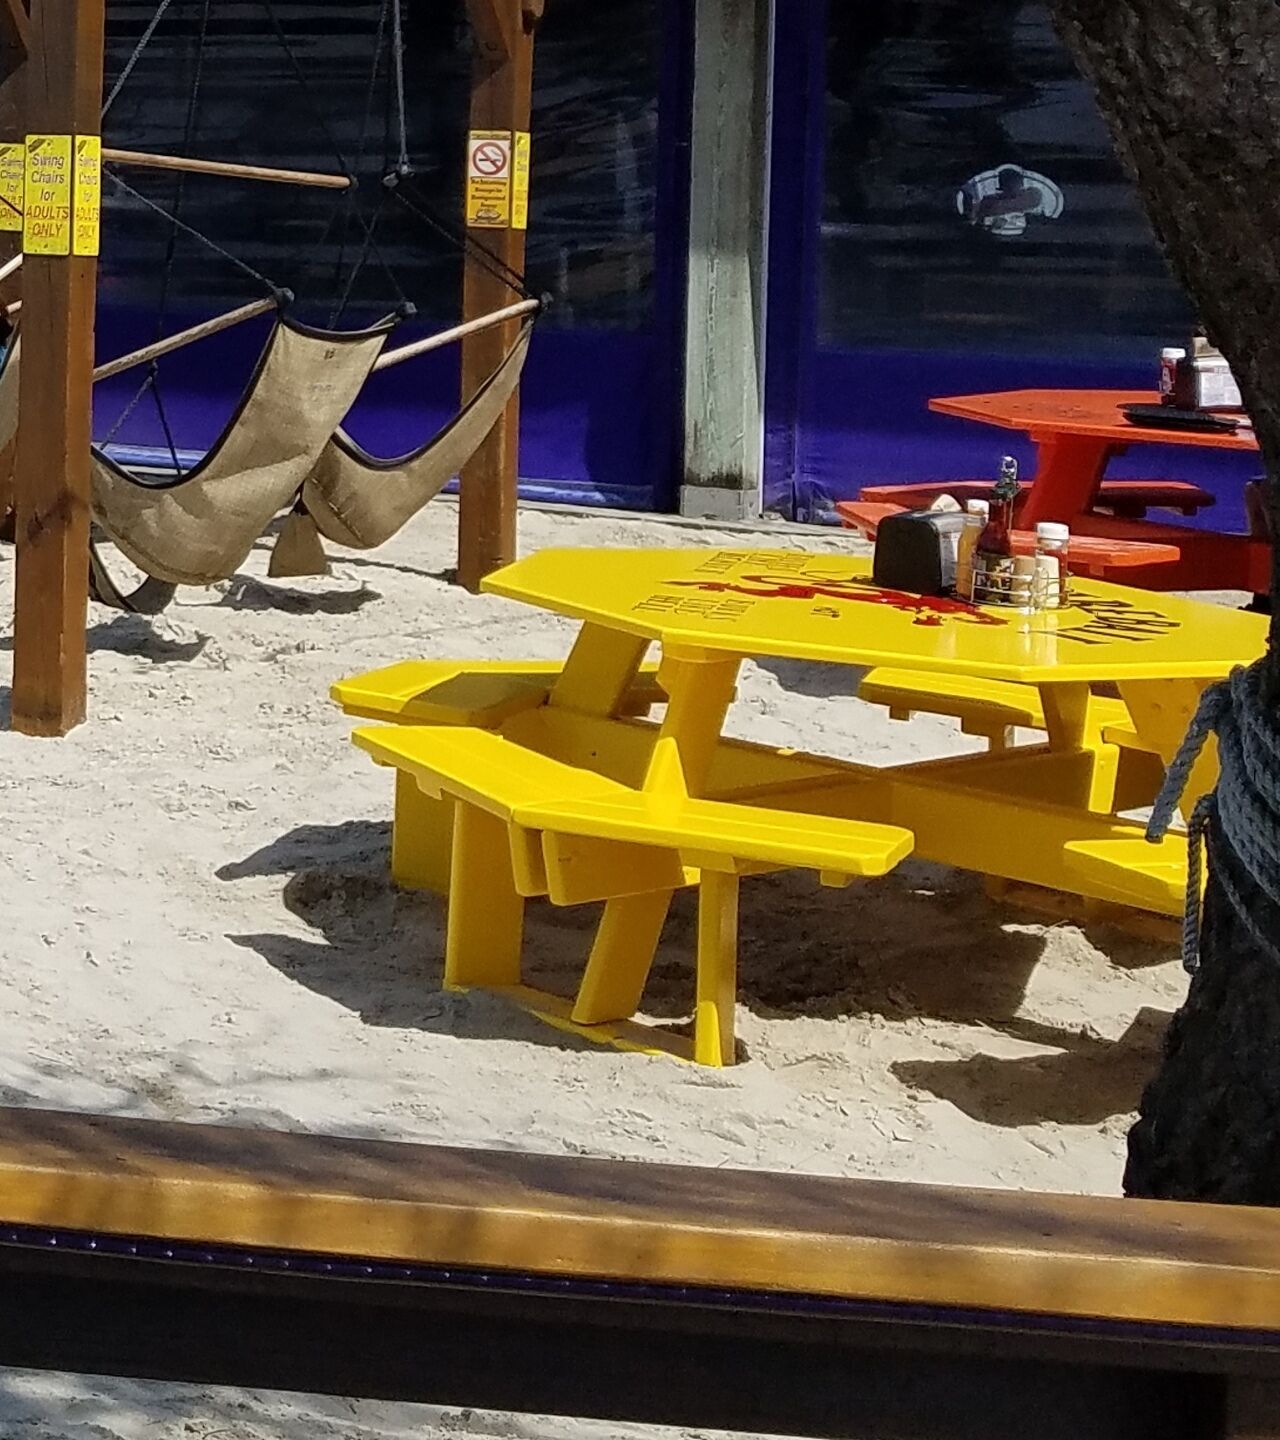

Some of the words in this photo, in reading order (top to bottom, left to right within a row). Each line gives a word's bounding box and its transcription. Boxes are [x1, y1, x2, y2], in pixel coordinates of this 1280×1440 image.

[31, 153, 65, 169] Swing
[31, 170, 65, 185] Chairs
[40, 188, 55, 202] for
[26, 205, 69, 220] ADULTS
[31, 222, 64, 238] ONLY
